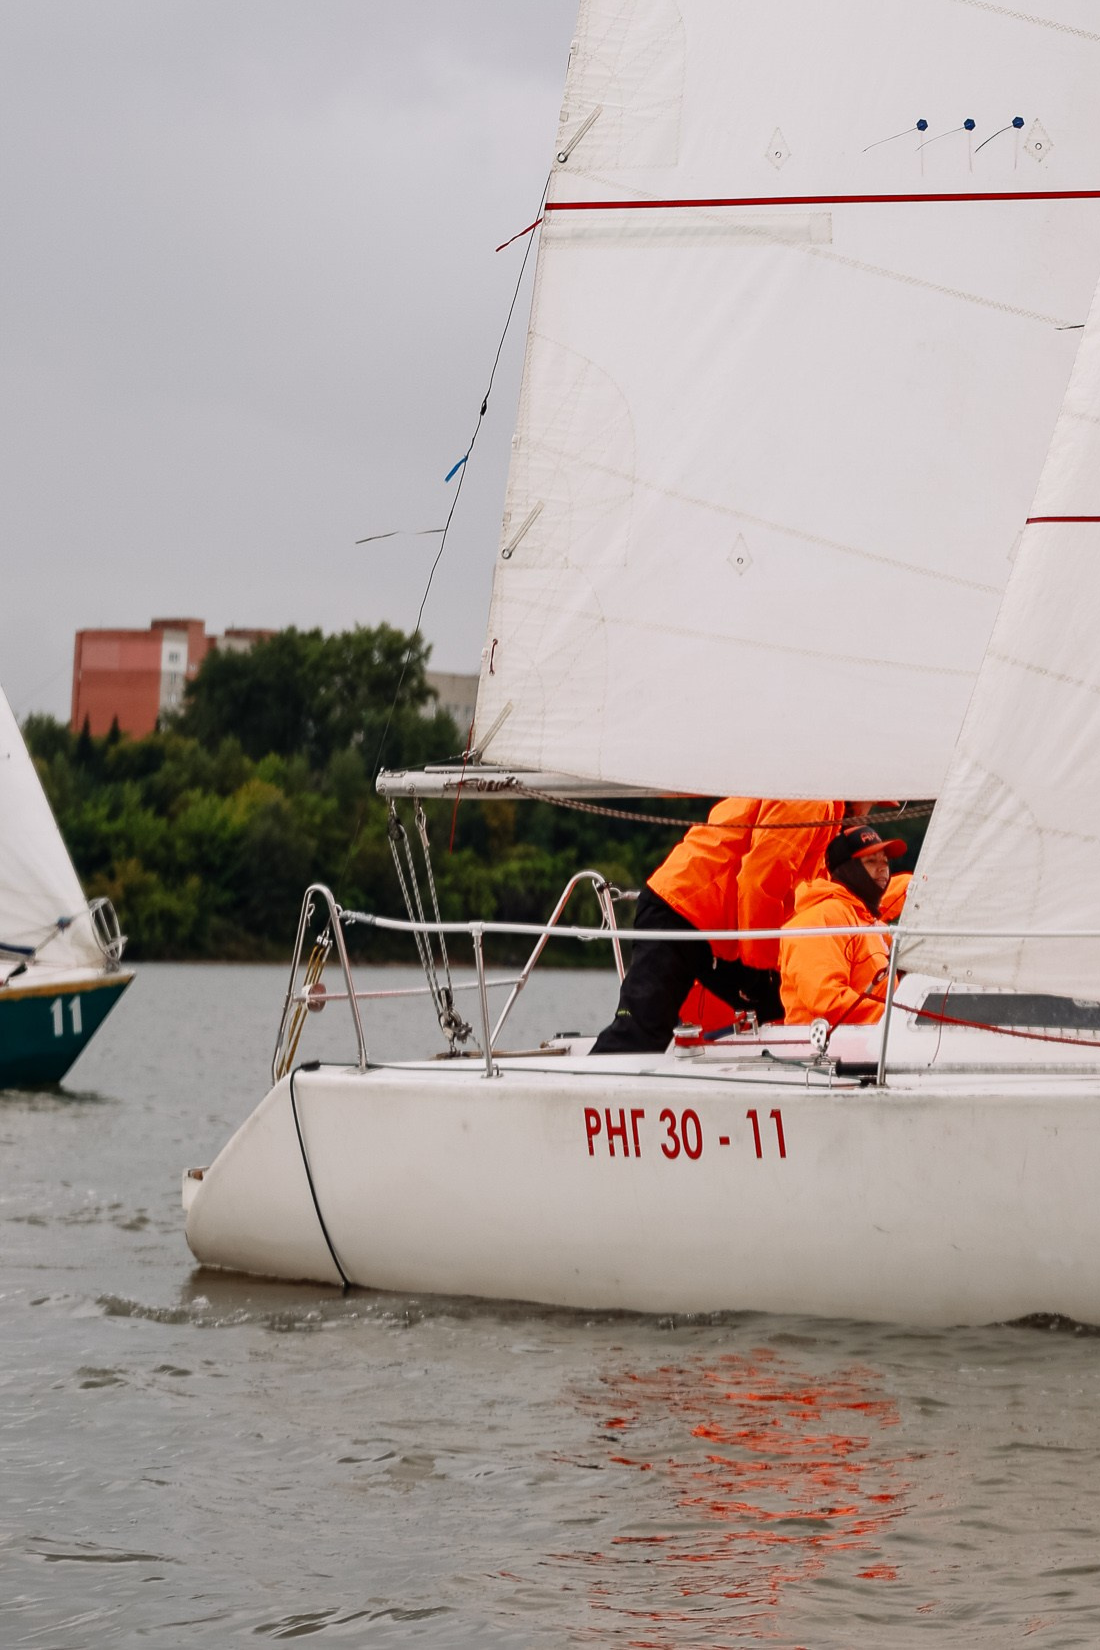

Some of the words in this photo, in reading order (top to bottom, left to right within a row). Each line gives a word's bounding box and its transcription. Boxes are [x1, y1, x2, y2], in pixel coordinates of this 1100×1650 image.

[51, 995, 83, 1037] 11
[584, 1107, 645, 1157] РНГ
[659, 1108, 703, 1160] 30
[746, 1109, 786, 1158] 11
